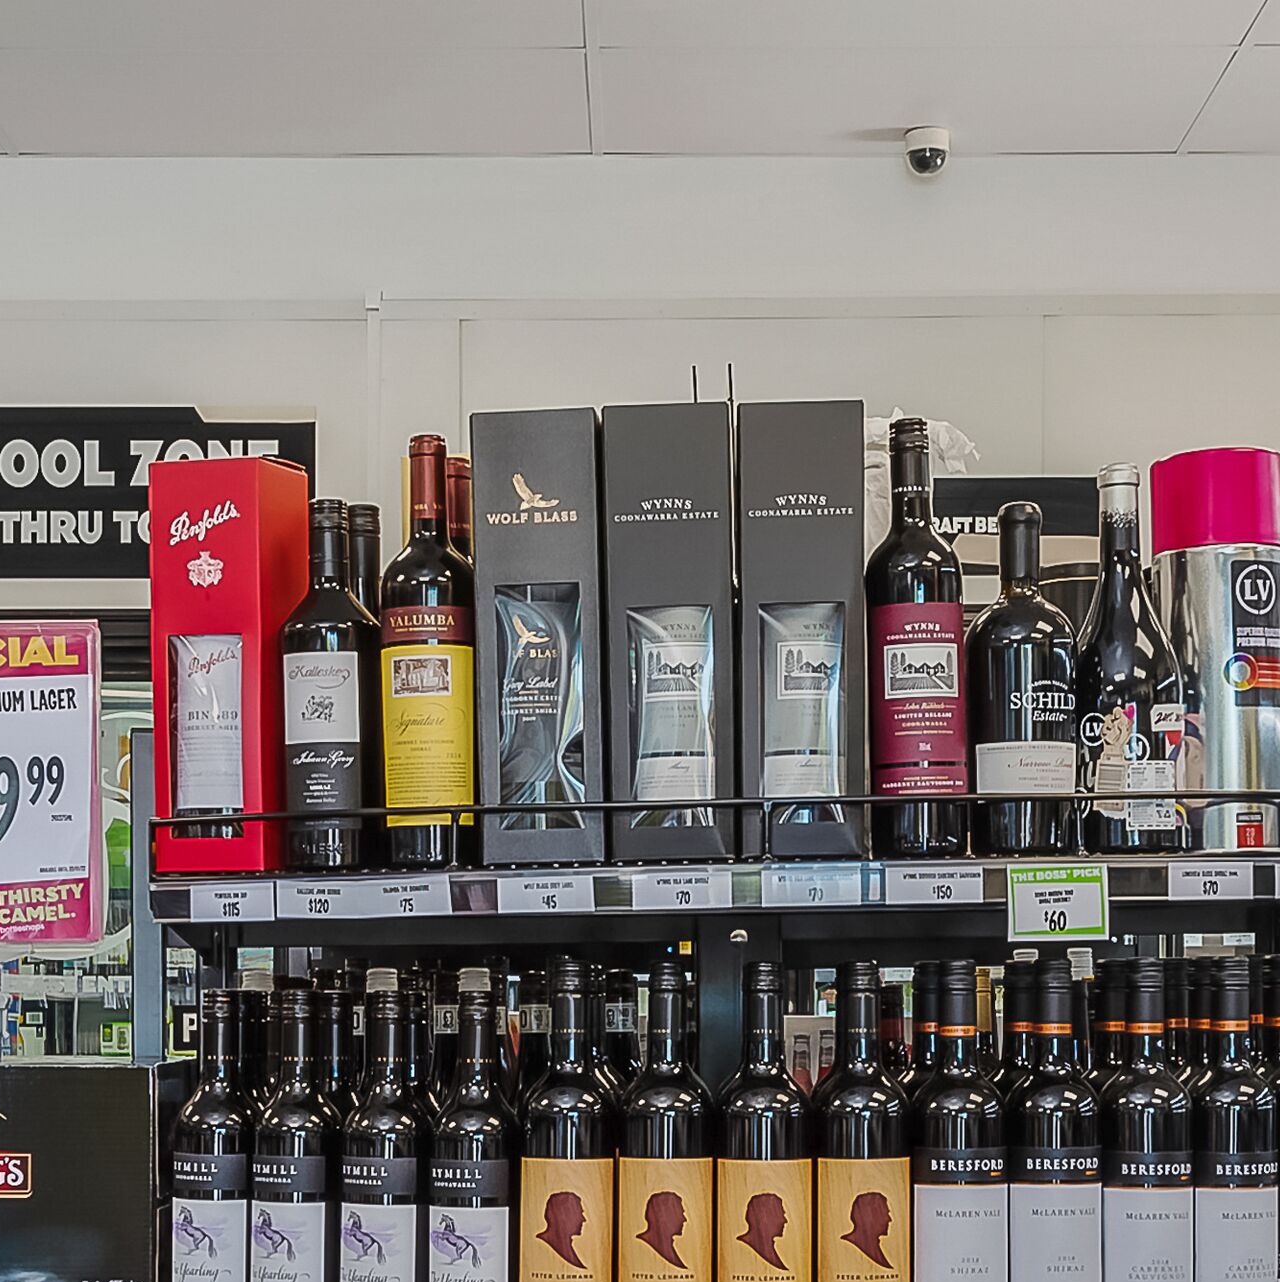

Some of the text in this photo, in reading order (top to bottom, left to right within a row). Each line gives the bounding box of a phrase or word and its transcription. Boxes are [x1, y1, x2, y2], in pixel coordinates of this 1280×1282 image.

[640, 499, 693, 511] WYNNS
[775, 494, 828, 507] WYNNS
[487, 511, 578, 524] WOLF BLASS
[614, 511, 719, 523] COONAWARRA ESTATE
[748, 507, 854, 518] COONAWARRA ESTATE
[1244, 580, 1270, 600] LV
[389, 614, 455, 628] YALUMBA
[904, 623, 940, 631] WYNNS
[30, 688, 77, 711] LAGER
[1011, 692, 1075, 710] SCHILD
[1012, 872, 1034, 882] THE
[1073, 867, 1101, 879] PICK
[932, 885, 952, 899] $150
[1203, 880, 1218, 895] $70
[222, 902, 240, 917] $115
[308, 898, 329, 913] $120
[1045, 910, 1067, 932] $60
[931, 1158, 1004, 1172] BERESFORD
[1026, 1157, 1098, 1170] BERESFORD
[1122, 1163, 1192, 1176] BERESFORD
